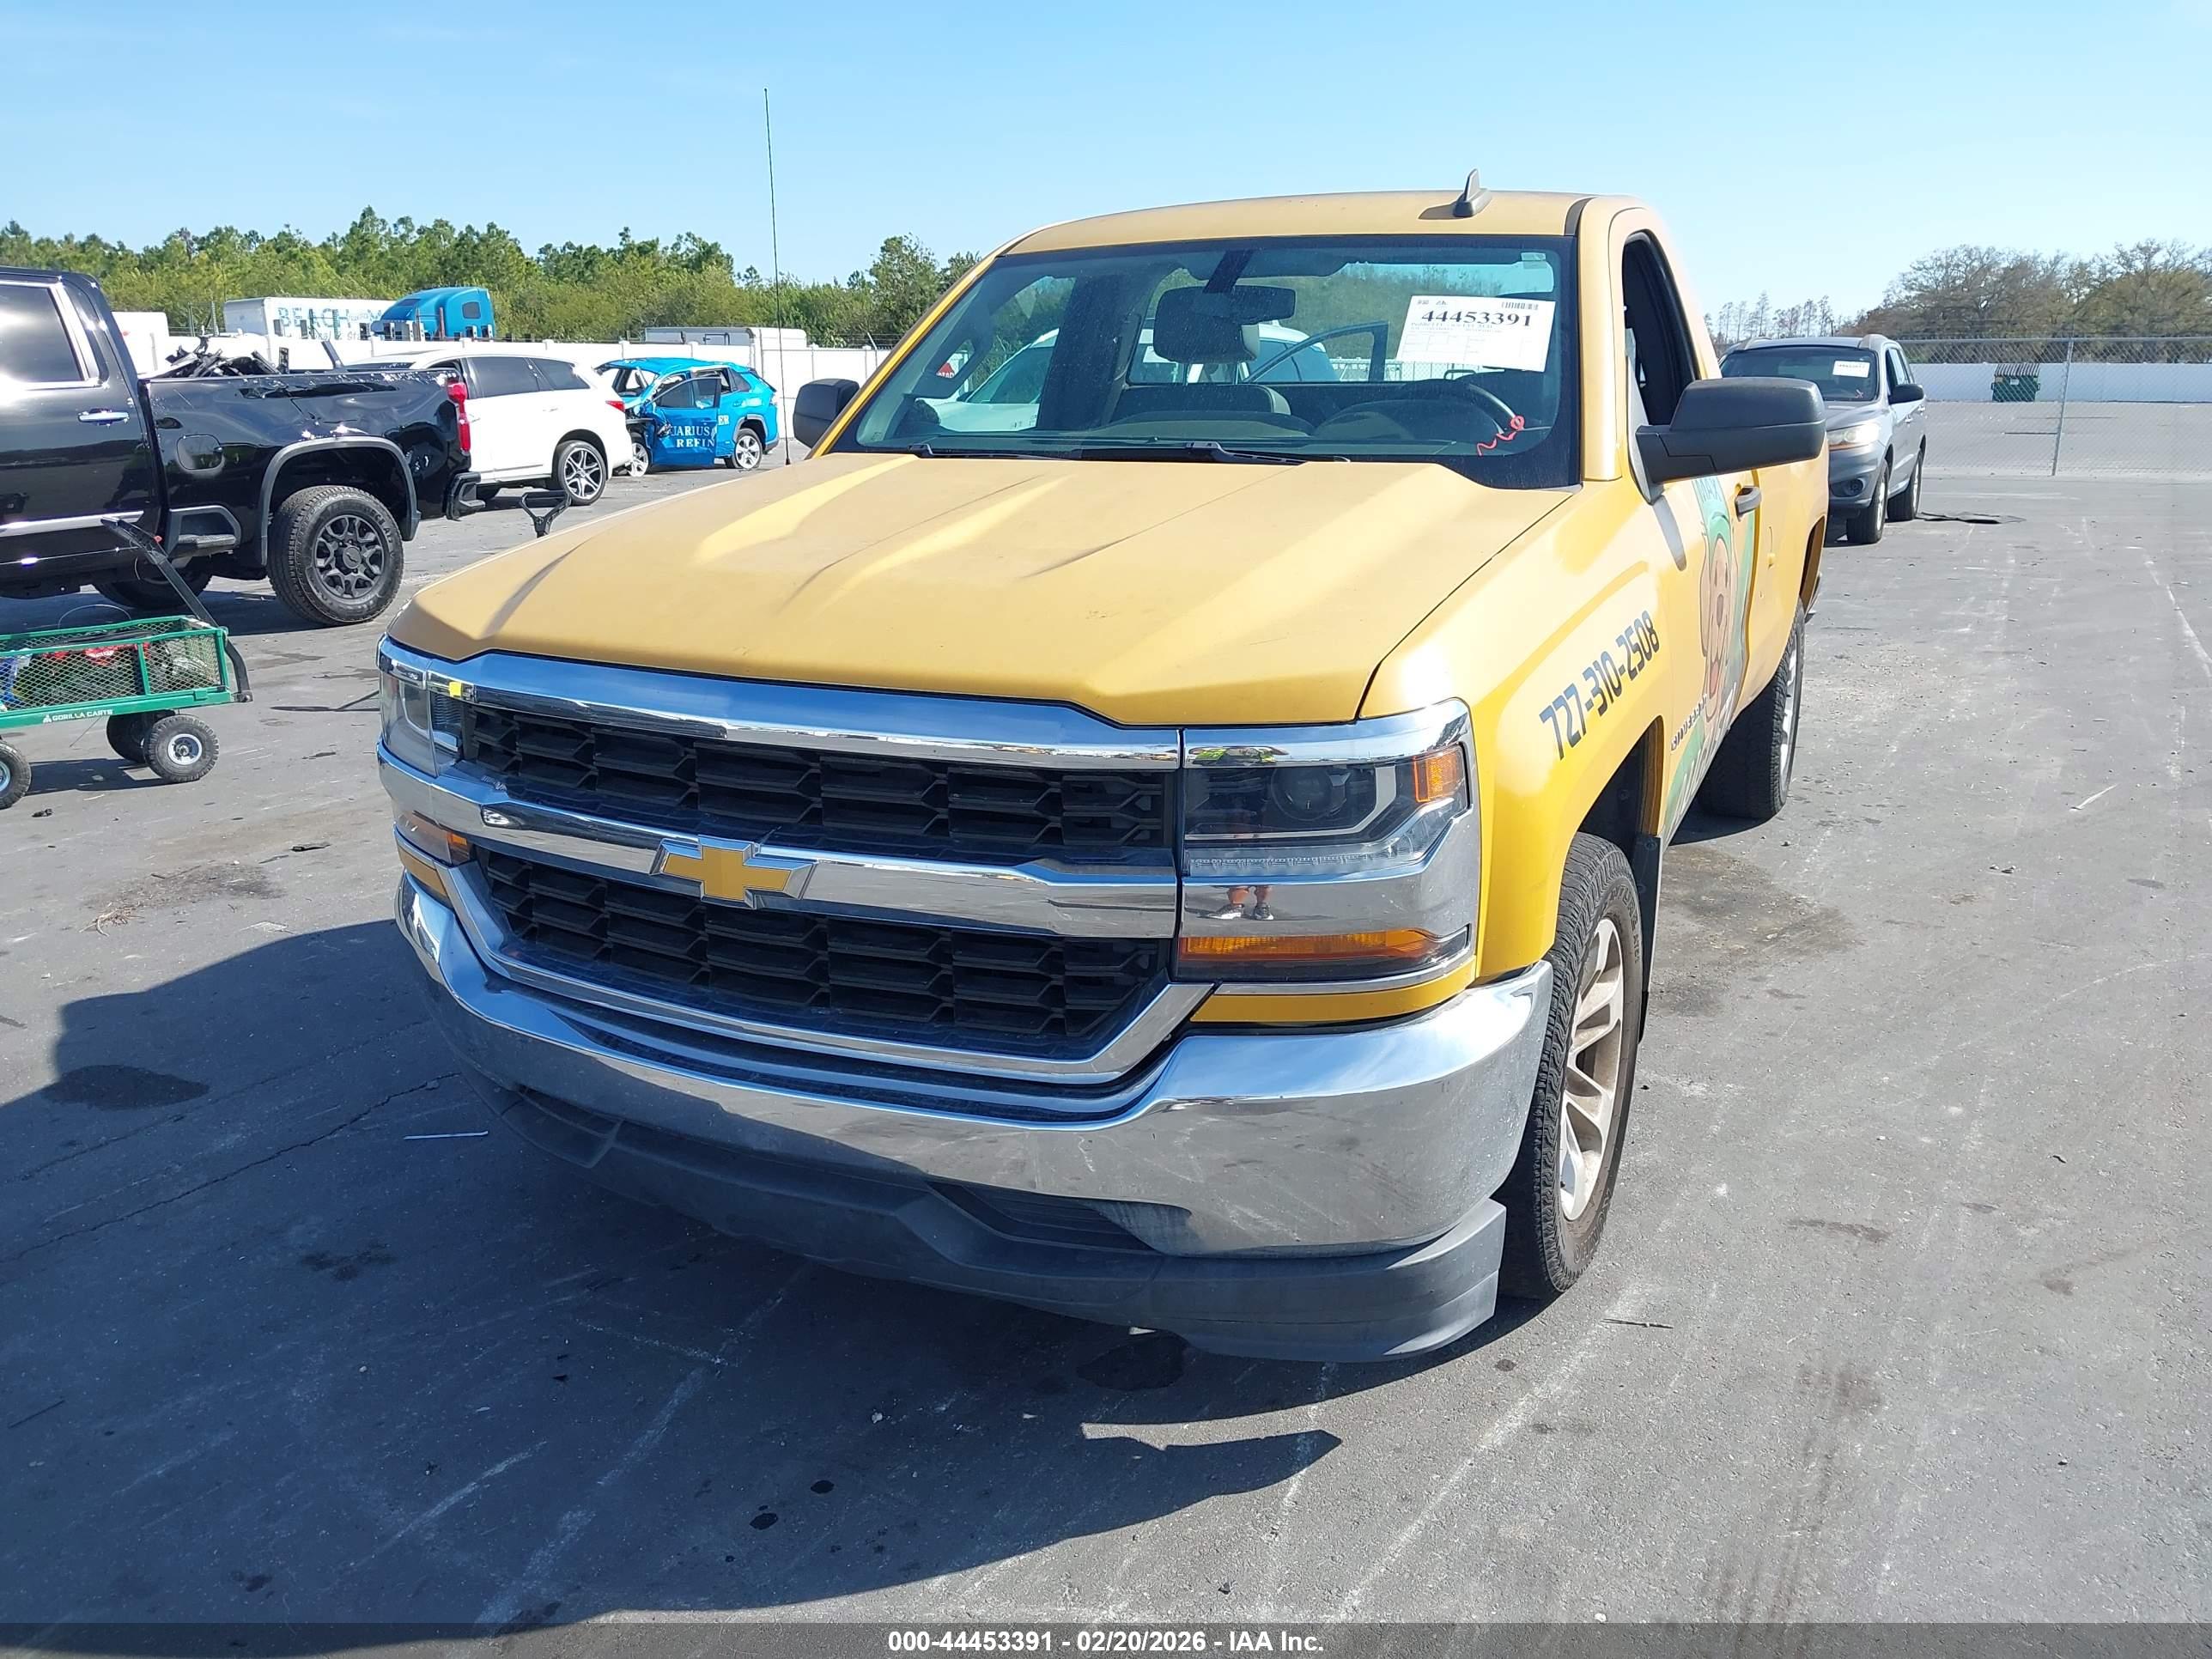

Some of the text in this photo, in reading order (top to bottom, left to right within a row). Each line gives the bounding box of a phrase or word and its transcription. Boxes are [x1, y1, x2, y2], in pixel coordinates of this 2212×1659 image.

[1422, 310, 1531, 327] 44453391
[1539, 611, 1660, 761] 727-310-2508
[52, 712, 86, 721] GORILLA
